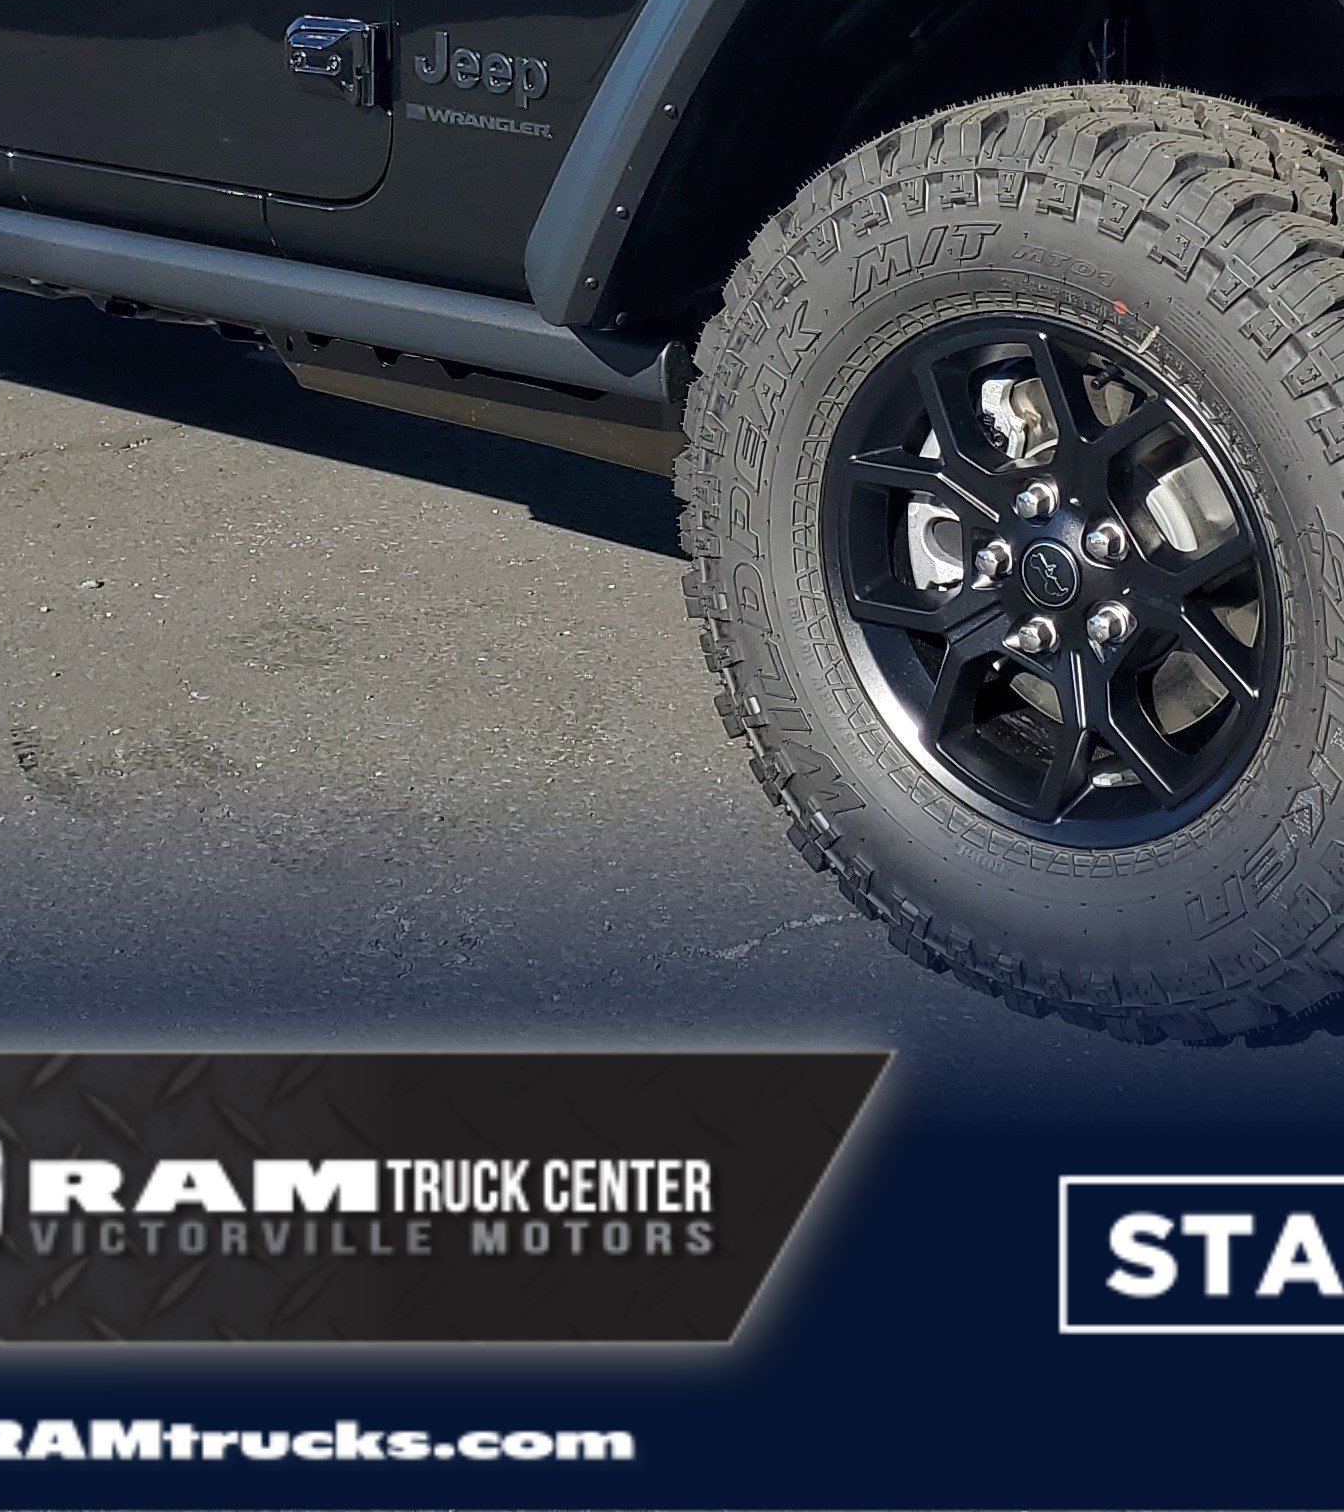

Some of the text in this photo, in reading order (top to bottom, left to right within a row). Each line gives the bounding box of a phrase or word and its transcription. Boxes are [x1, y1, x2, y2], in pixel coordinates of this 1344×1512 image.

[415, 31, 549, 110] Jeep
[426, 106, 551, 139] WRANGLER
[729, 299, 867, 817] WILDPEAK
